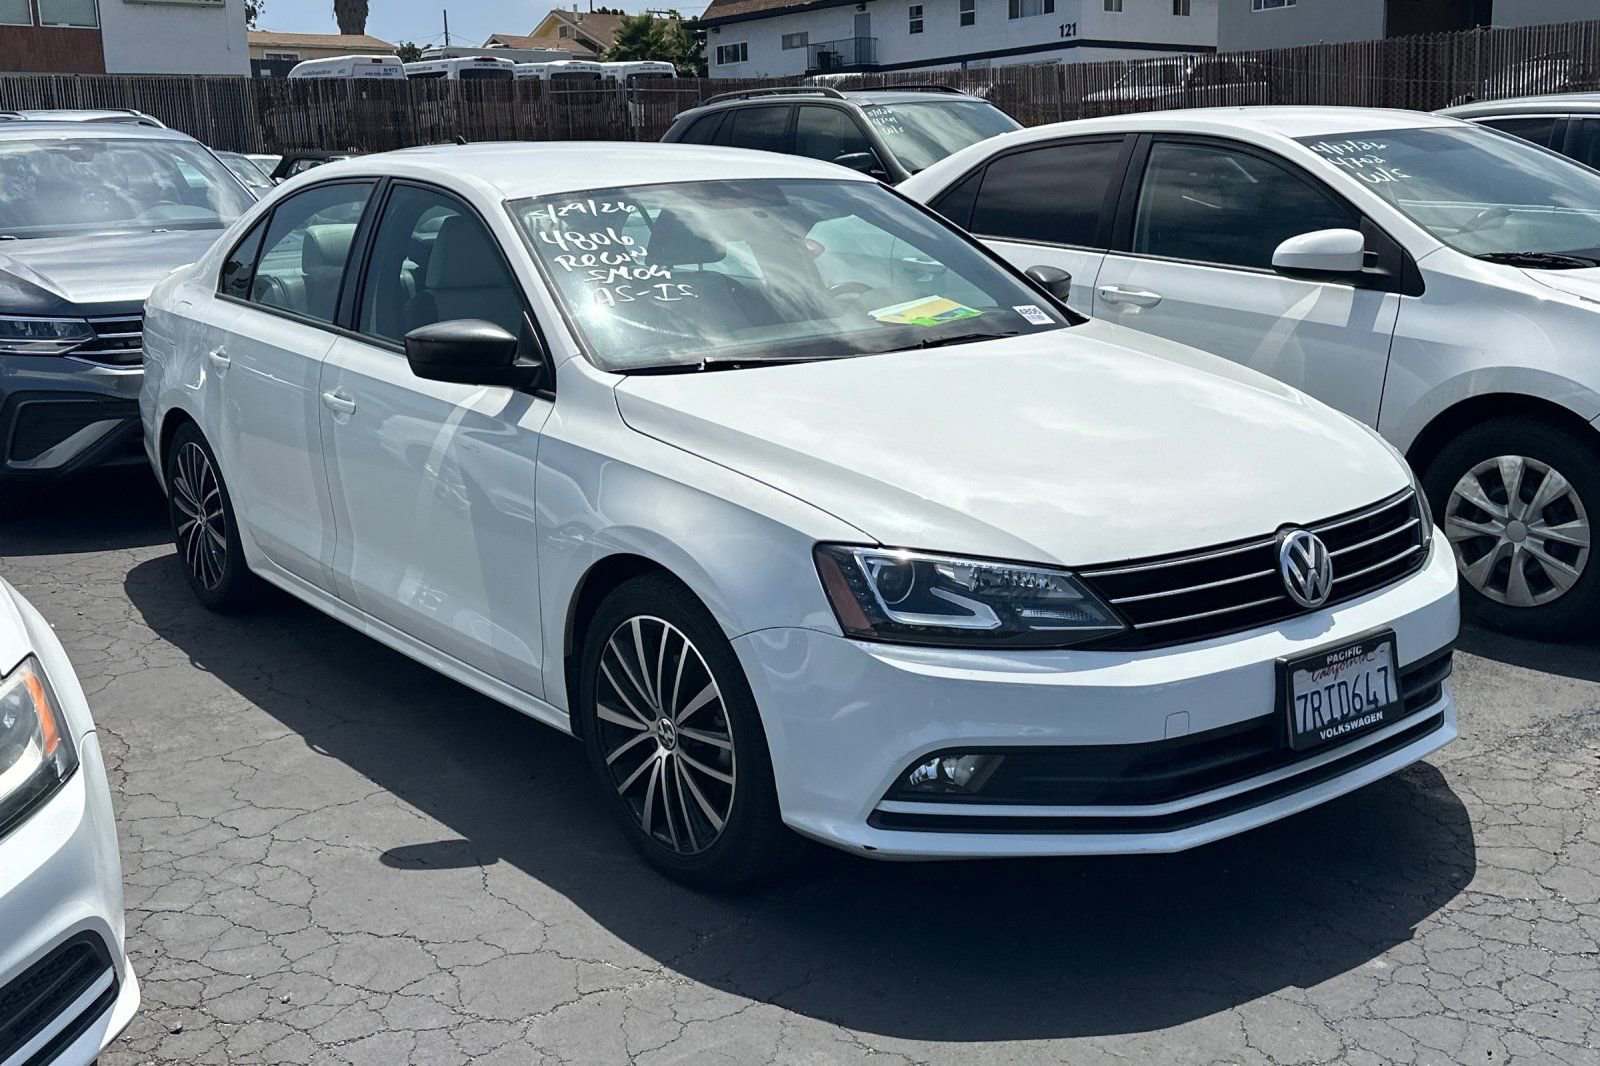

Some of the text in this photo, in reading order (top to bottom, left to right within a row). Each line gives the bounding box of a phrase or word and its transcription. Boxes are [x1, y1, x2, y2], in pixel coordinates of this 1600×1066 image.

[1059, 22, 1077, 38] 121
[539, 228, 635, 251] 4806
[1326, 645, 1363, 665] PACIFIC
[1319, 710, 1384, 740] VOLKSWAGEN
